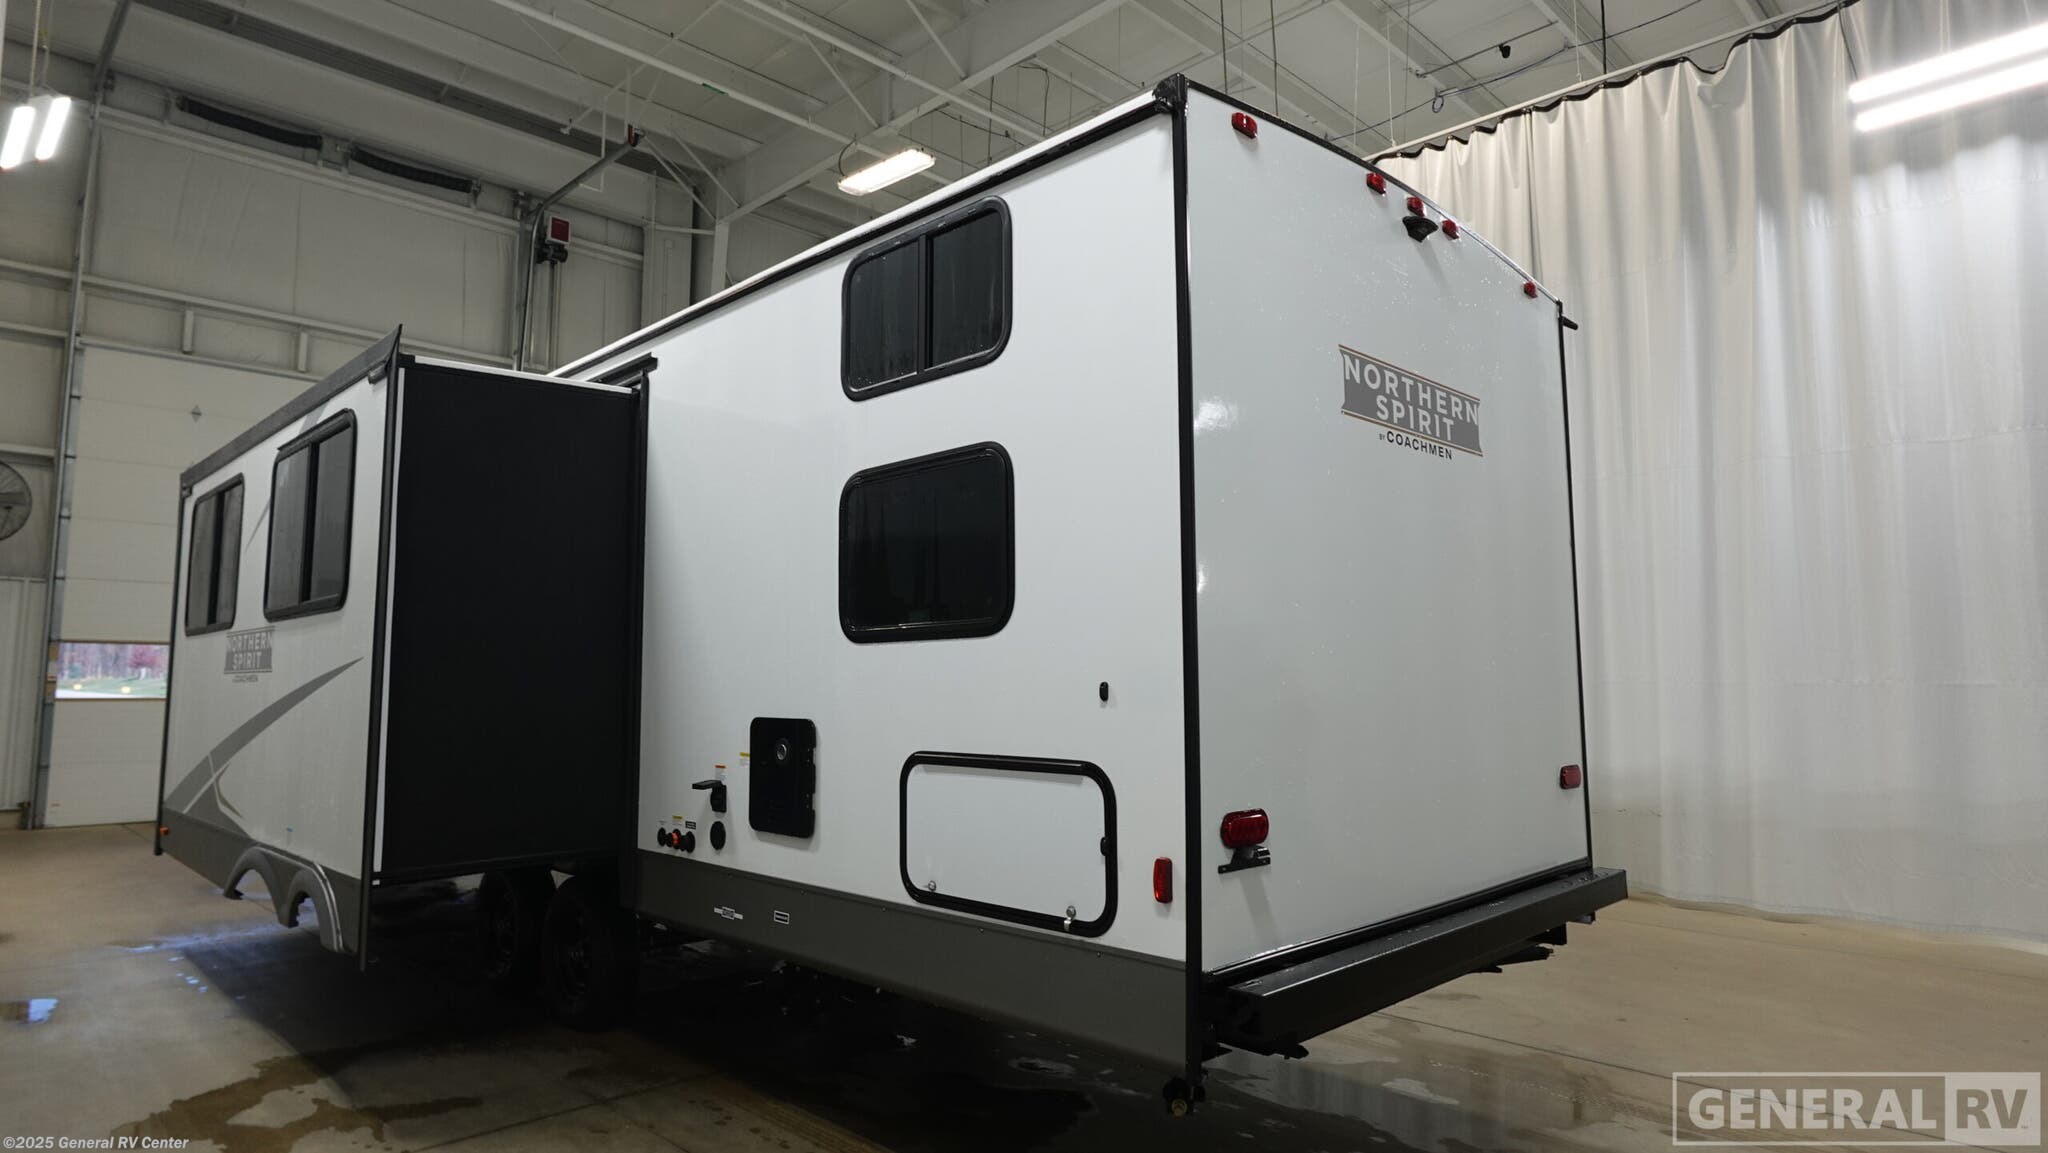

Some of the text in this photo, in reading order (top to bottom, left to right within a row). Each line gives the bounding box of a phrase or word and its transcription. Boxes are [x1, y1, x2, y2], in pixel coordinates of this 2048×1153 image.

[1343, 354, 1479, 425] NORTHERN
[1376, 395, 1454, 441] SPIRIT
[1386, 431, 1453, 460] COACHMEN
[232, 651, 262, 671] SPIRIT
